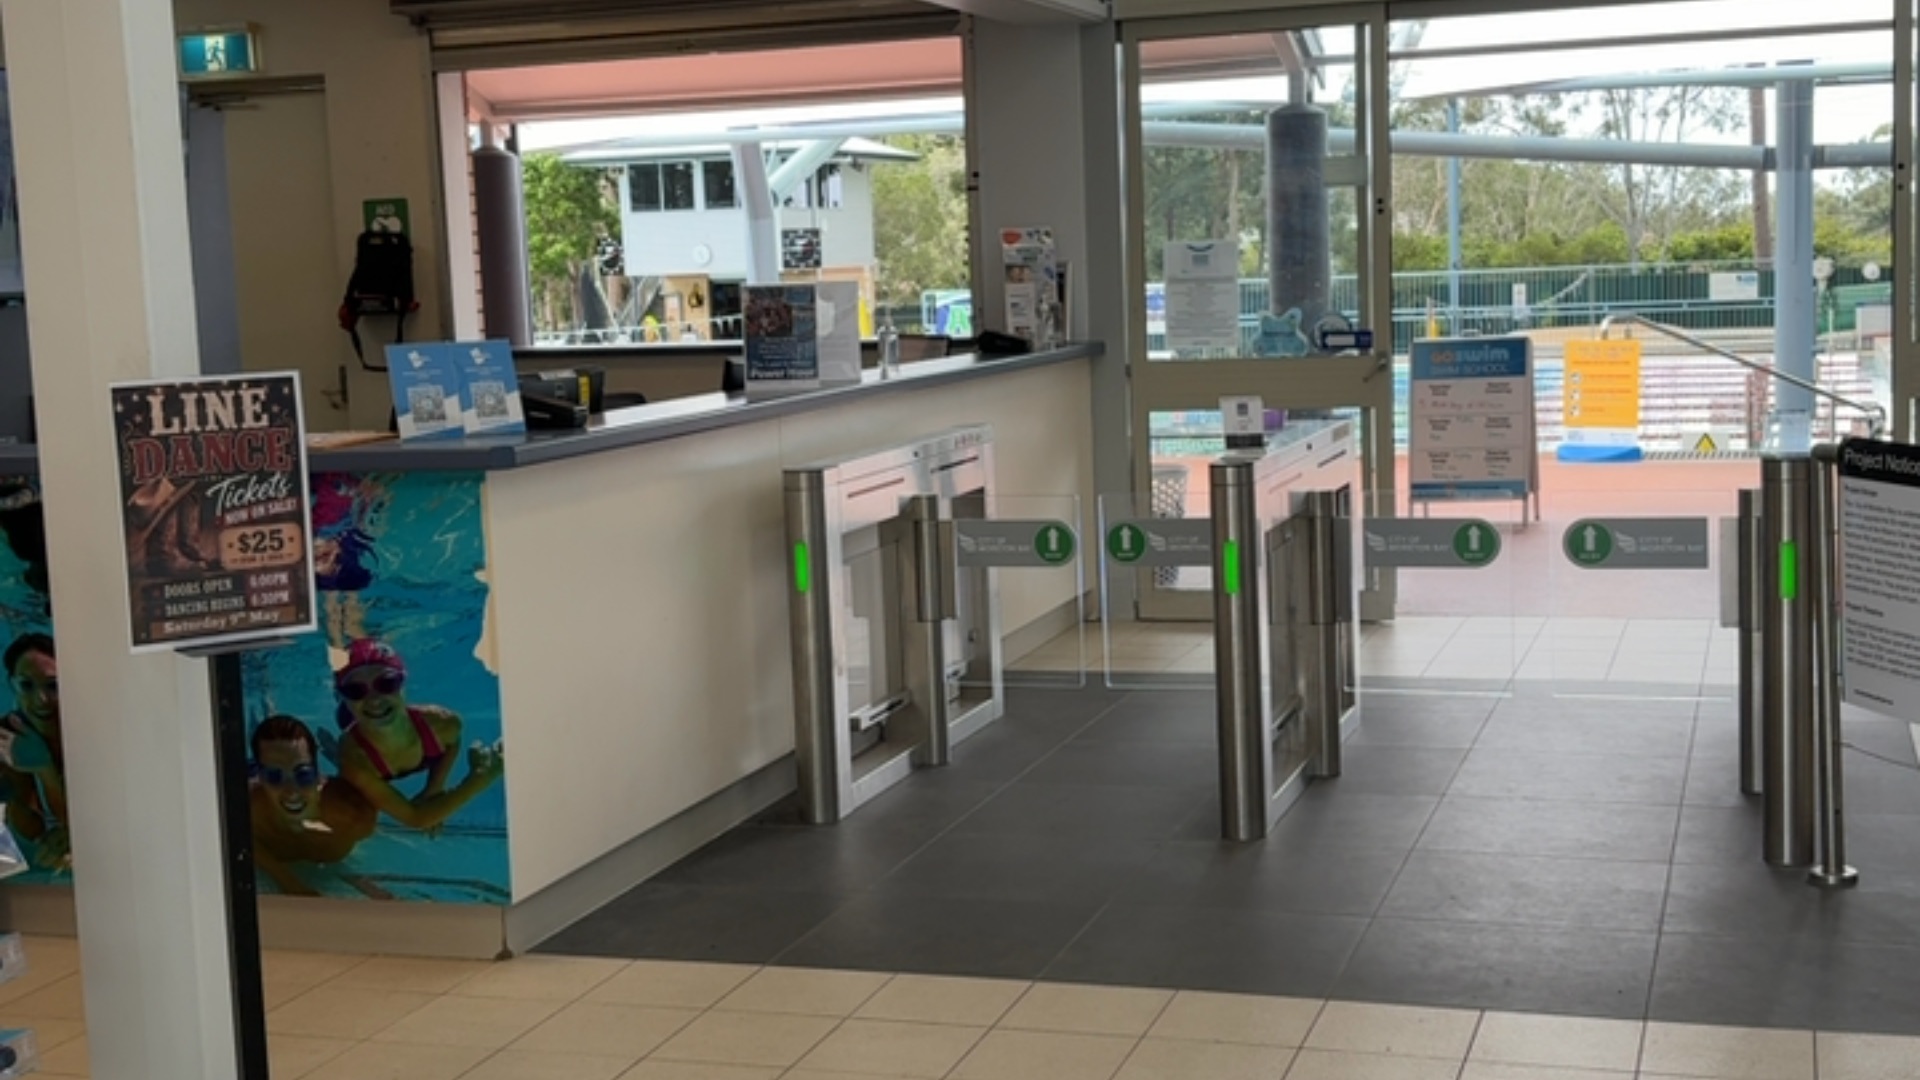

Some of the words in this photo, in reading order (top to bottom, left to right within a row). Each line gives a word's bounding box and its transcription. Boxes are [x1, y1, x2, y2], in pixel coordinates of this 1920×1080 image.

[146, 384, 270, 436] LINE
[128, 427, 292, 485] DANCE
[1845, 447, 1883, 472] Project
[205, 471, 291, 516] Tickets
[238, 528, 284, 554] $25
[164, 581, 200, 599] DOORS
[202, 577, 233, 596] OPEN
[164, 600, 209, 617] DANCING
[210, 595, 246, 613] BEGINS
[164, 616, 227, 634] Saturday
[250, 609, 281, 623] May
